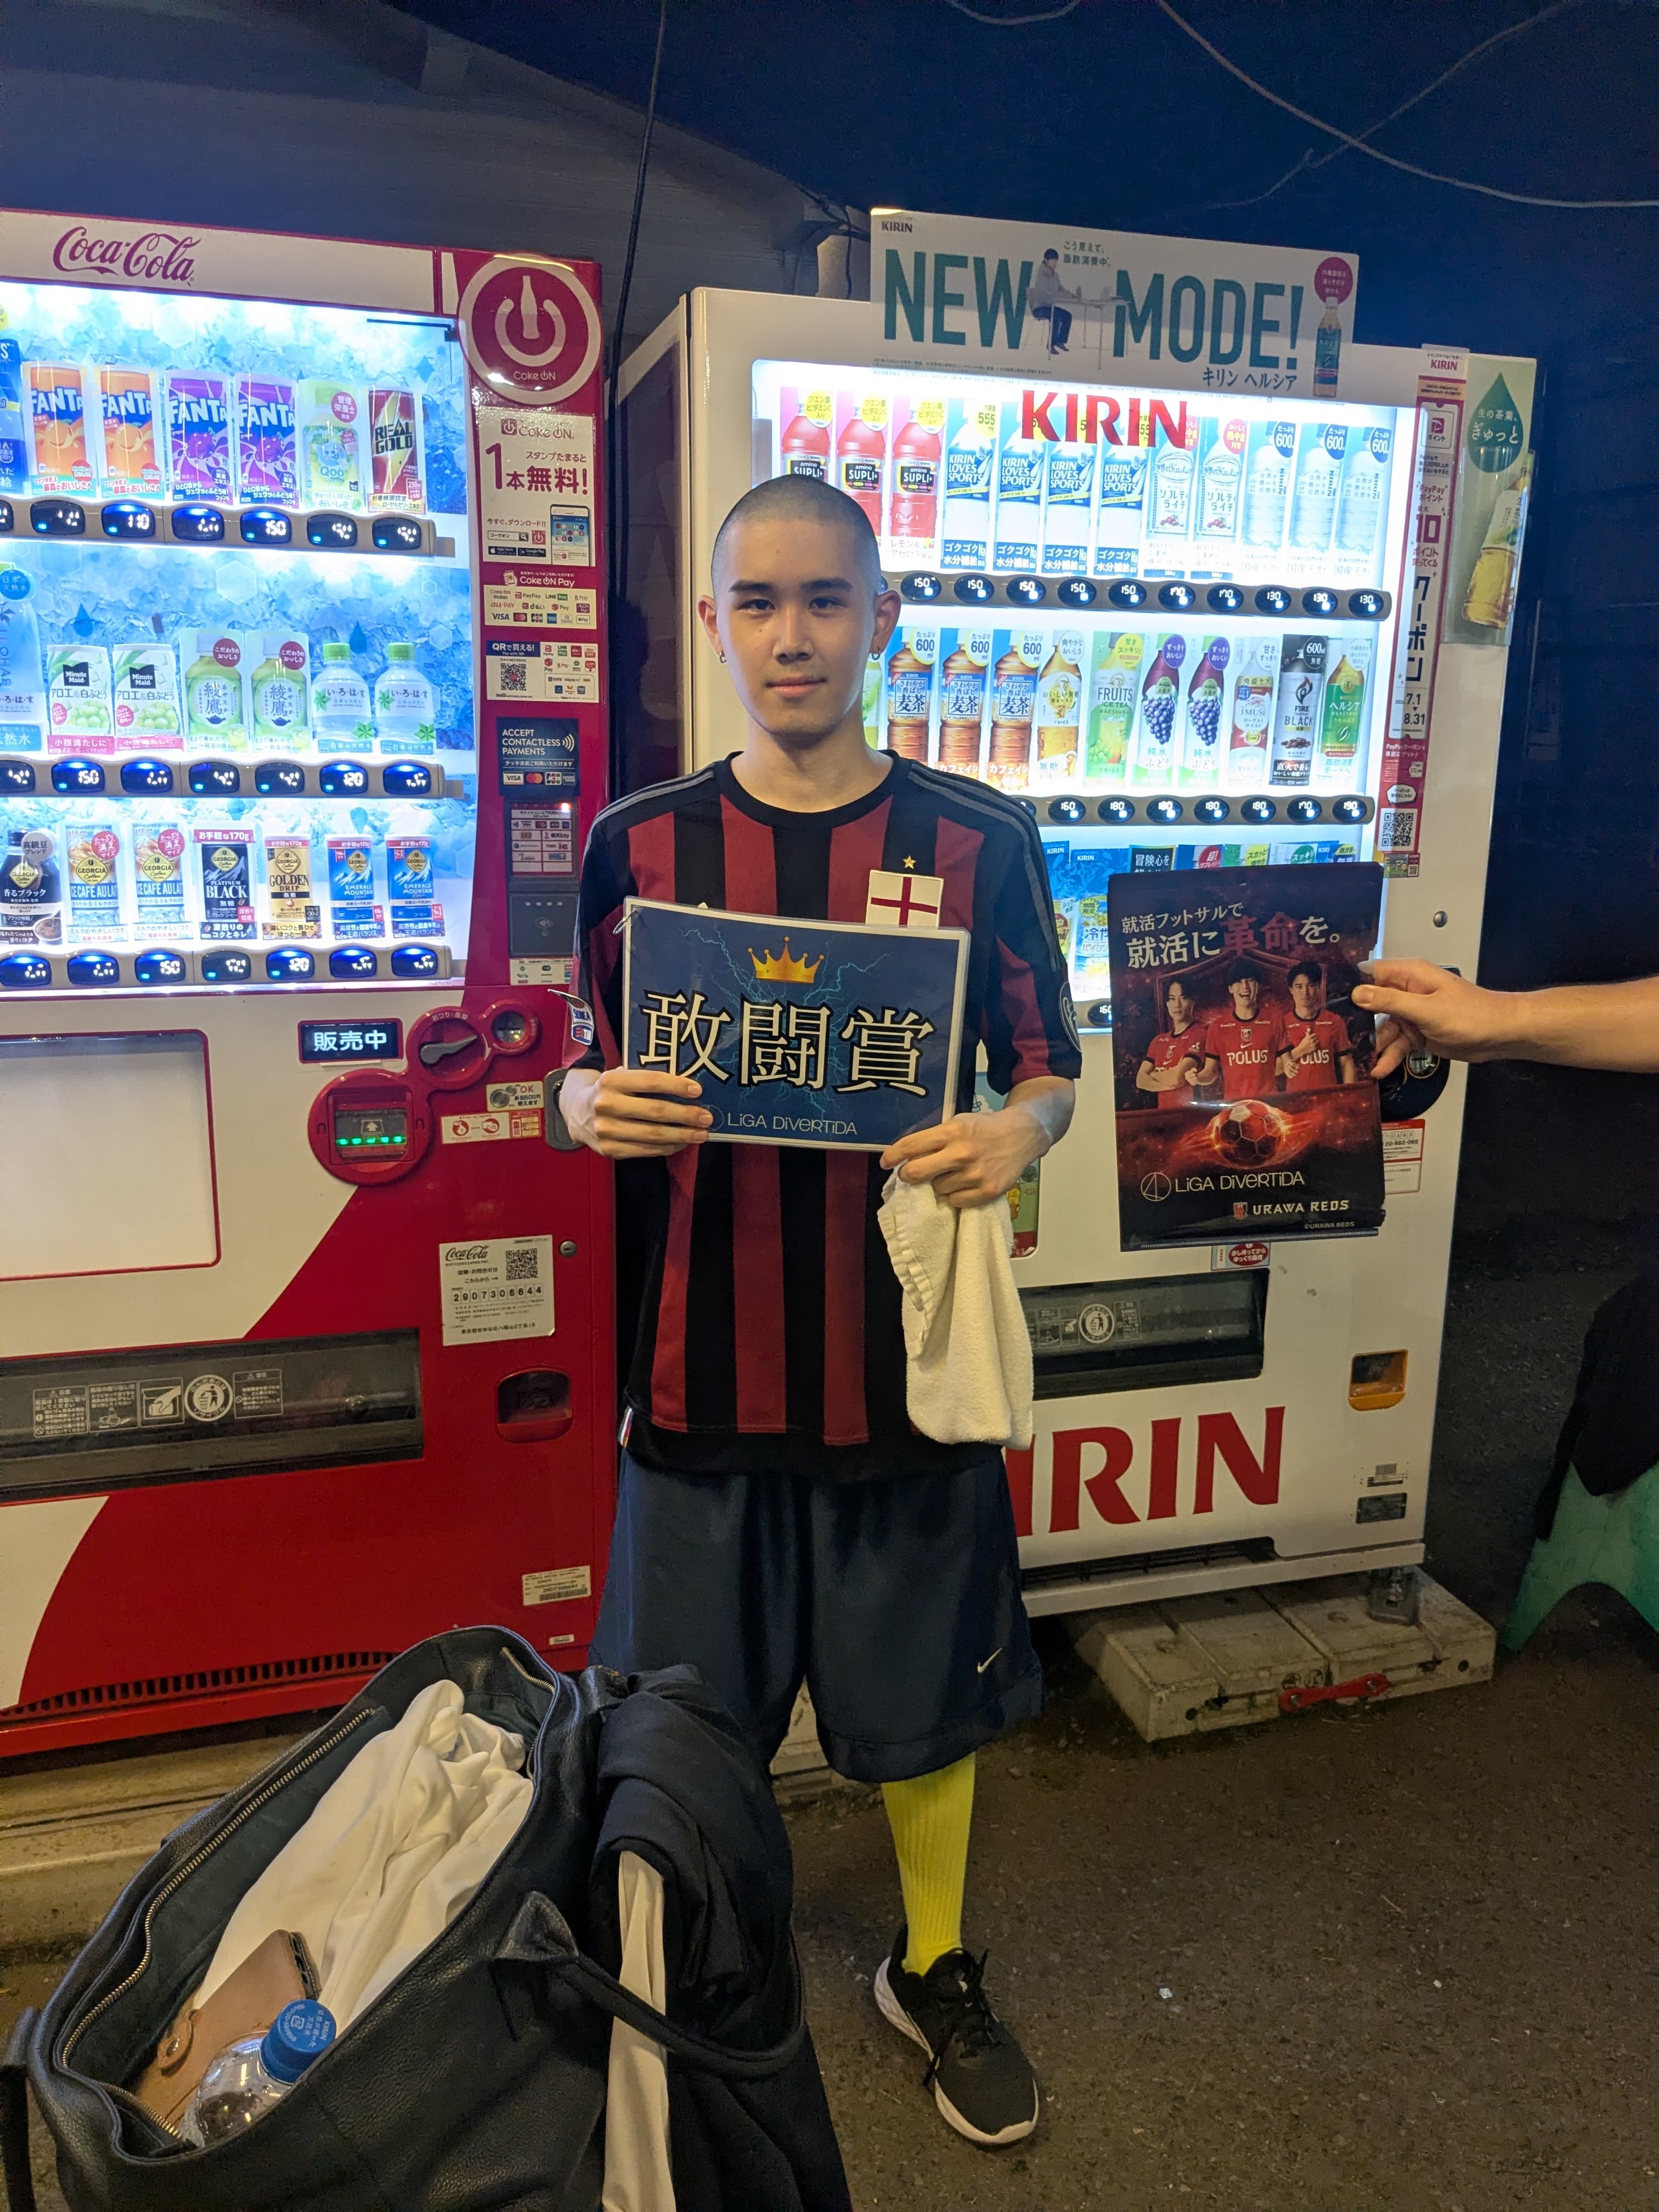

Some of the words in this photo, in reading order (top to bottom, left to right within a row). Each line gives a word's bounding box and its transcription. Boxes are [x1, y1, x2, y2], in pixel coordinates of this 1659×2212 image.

[881, 221, 913, 233] KIRIN
[53, 227, 201, 282] Coca-Cola
[884, 249, 1034, 349] NEW
[1113, 269, 1304, 370] MODE!
[1430, 359, 1458, 371] KIRIN
[514, 371, 539, 380] Coke
[541, 370, 556, 380] ON
[1203, 367, 1239, 388] キリン
[1244, 373, 1297, 392] ヘルシア
[170, 398, 228, 424] FANTA
[240, 402, 295, 428] FANTA
[978, 412, 996, 425] 555
[1021, 390, 1187, 449] KIRIN
[375, 423, 413, 439] REAL
[519, 426, 550, 437] Coke
[1278, 425, 1294, 433] たっぷり
[1329, 428, 1345, 436] たっぷり
[1374, 431, 1389, 439] たっぷり
[1471, 422, 1519, 444] ぎゅっと
[376, 437, 413, 455] GOLD
[526, 451, 586, 462] スタンプたまると
[949, 454, 975, 464] KIRIN
[1002, 457, 1028, 467] KIRIN
[948, 463, 977, 473] LOVES
[1001, 466, 1030, 477] LOVES
[1051, 460, 1077, 471] KIRIN
[1104, 464, 1130, 474] KIRIN
[320, 466, 345, 478] Qoo
[948, 472, 983, 483] SPORTS
[1050, 470, 1079, 480] LOVES
[1103, 473, 1132, 483] LOVES
[1001, 476, 1036, 486] SPORTS
[1050, 479, 1085, 489] SPORTS
[1103, 482, 1138, 493] SPORTS
[1419, 484, 1446, 496] PayPay
[1416, 514, 1442, 544] 10
[945, 543, 978, 554] ゴクゴク
[997, 545, 1030, 555] ゴクゴク
[1046, 548, 1079, 559] ゴクゴク
[1098, 550, 1131, 561] ゴクゴク
[520, 577, 541, 585] Coke
[543, 577, 556, 585] ON
[558, 578, 574, 589] Pay
[1406, 575, 1431, 682] クーポン
[916, 639, 935, 652] 600
[970, 640, 990, 654] 600
[1023, 642, 1042, 655] 600
[1166, 643, 1184, 651] すっきり
[1211, 646, 1229, 654] すっきり
[1263, 645, 1276, 653] 甘さ
[1243, 677, 1270, 686] 免疫ケア
[1097, 687, 1133, 702] FRUITS
[896, 695, 926, 713] 麦茶
[949, 696, 979, 714] 麦茶
[1001, 697, 1030, 715] 麦茶
[1329, 702, 1360, 712] ヘルシア
[1284, 715, 1313, 726] BLACK
[1403, 713, 1426, 725] 8.31
[502, 729, 535, 737] ACCEPT
[502, 738, 561, 747] CONTACTLESS
[1135, 854, 1170, 867] 冒険心を
[269, 874, 309, 887] GOLDEN
[4, 888, 46, 898] 香るブラック
[206, 885, 248, 898] BLACK
[1121, 902, 1245, 934] 就活フットサルで
[1126, 911, 1340, 969] 就活に革命を。
[313, 1029, 387, 1052] 販売中
[636, 989, 935, 1098] 敢闘賞
[1226, 1049, 1268, 1066] POLUS
[1300, 1049, 1330, 1065] OLUS
[520, 1085, 534, 1093] OK
[1253, 1203, 1304, 1216] URAWA
[1310, 1199, 1350, 1213] REDS
[445, 1245, 490, 1262] Coca-Cola
[1005, 1406, 1286, 1537] IRIN
